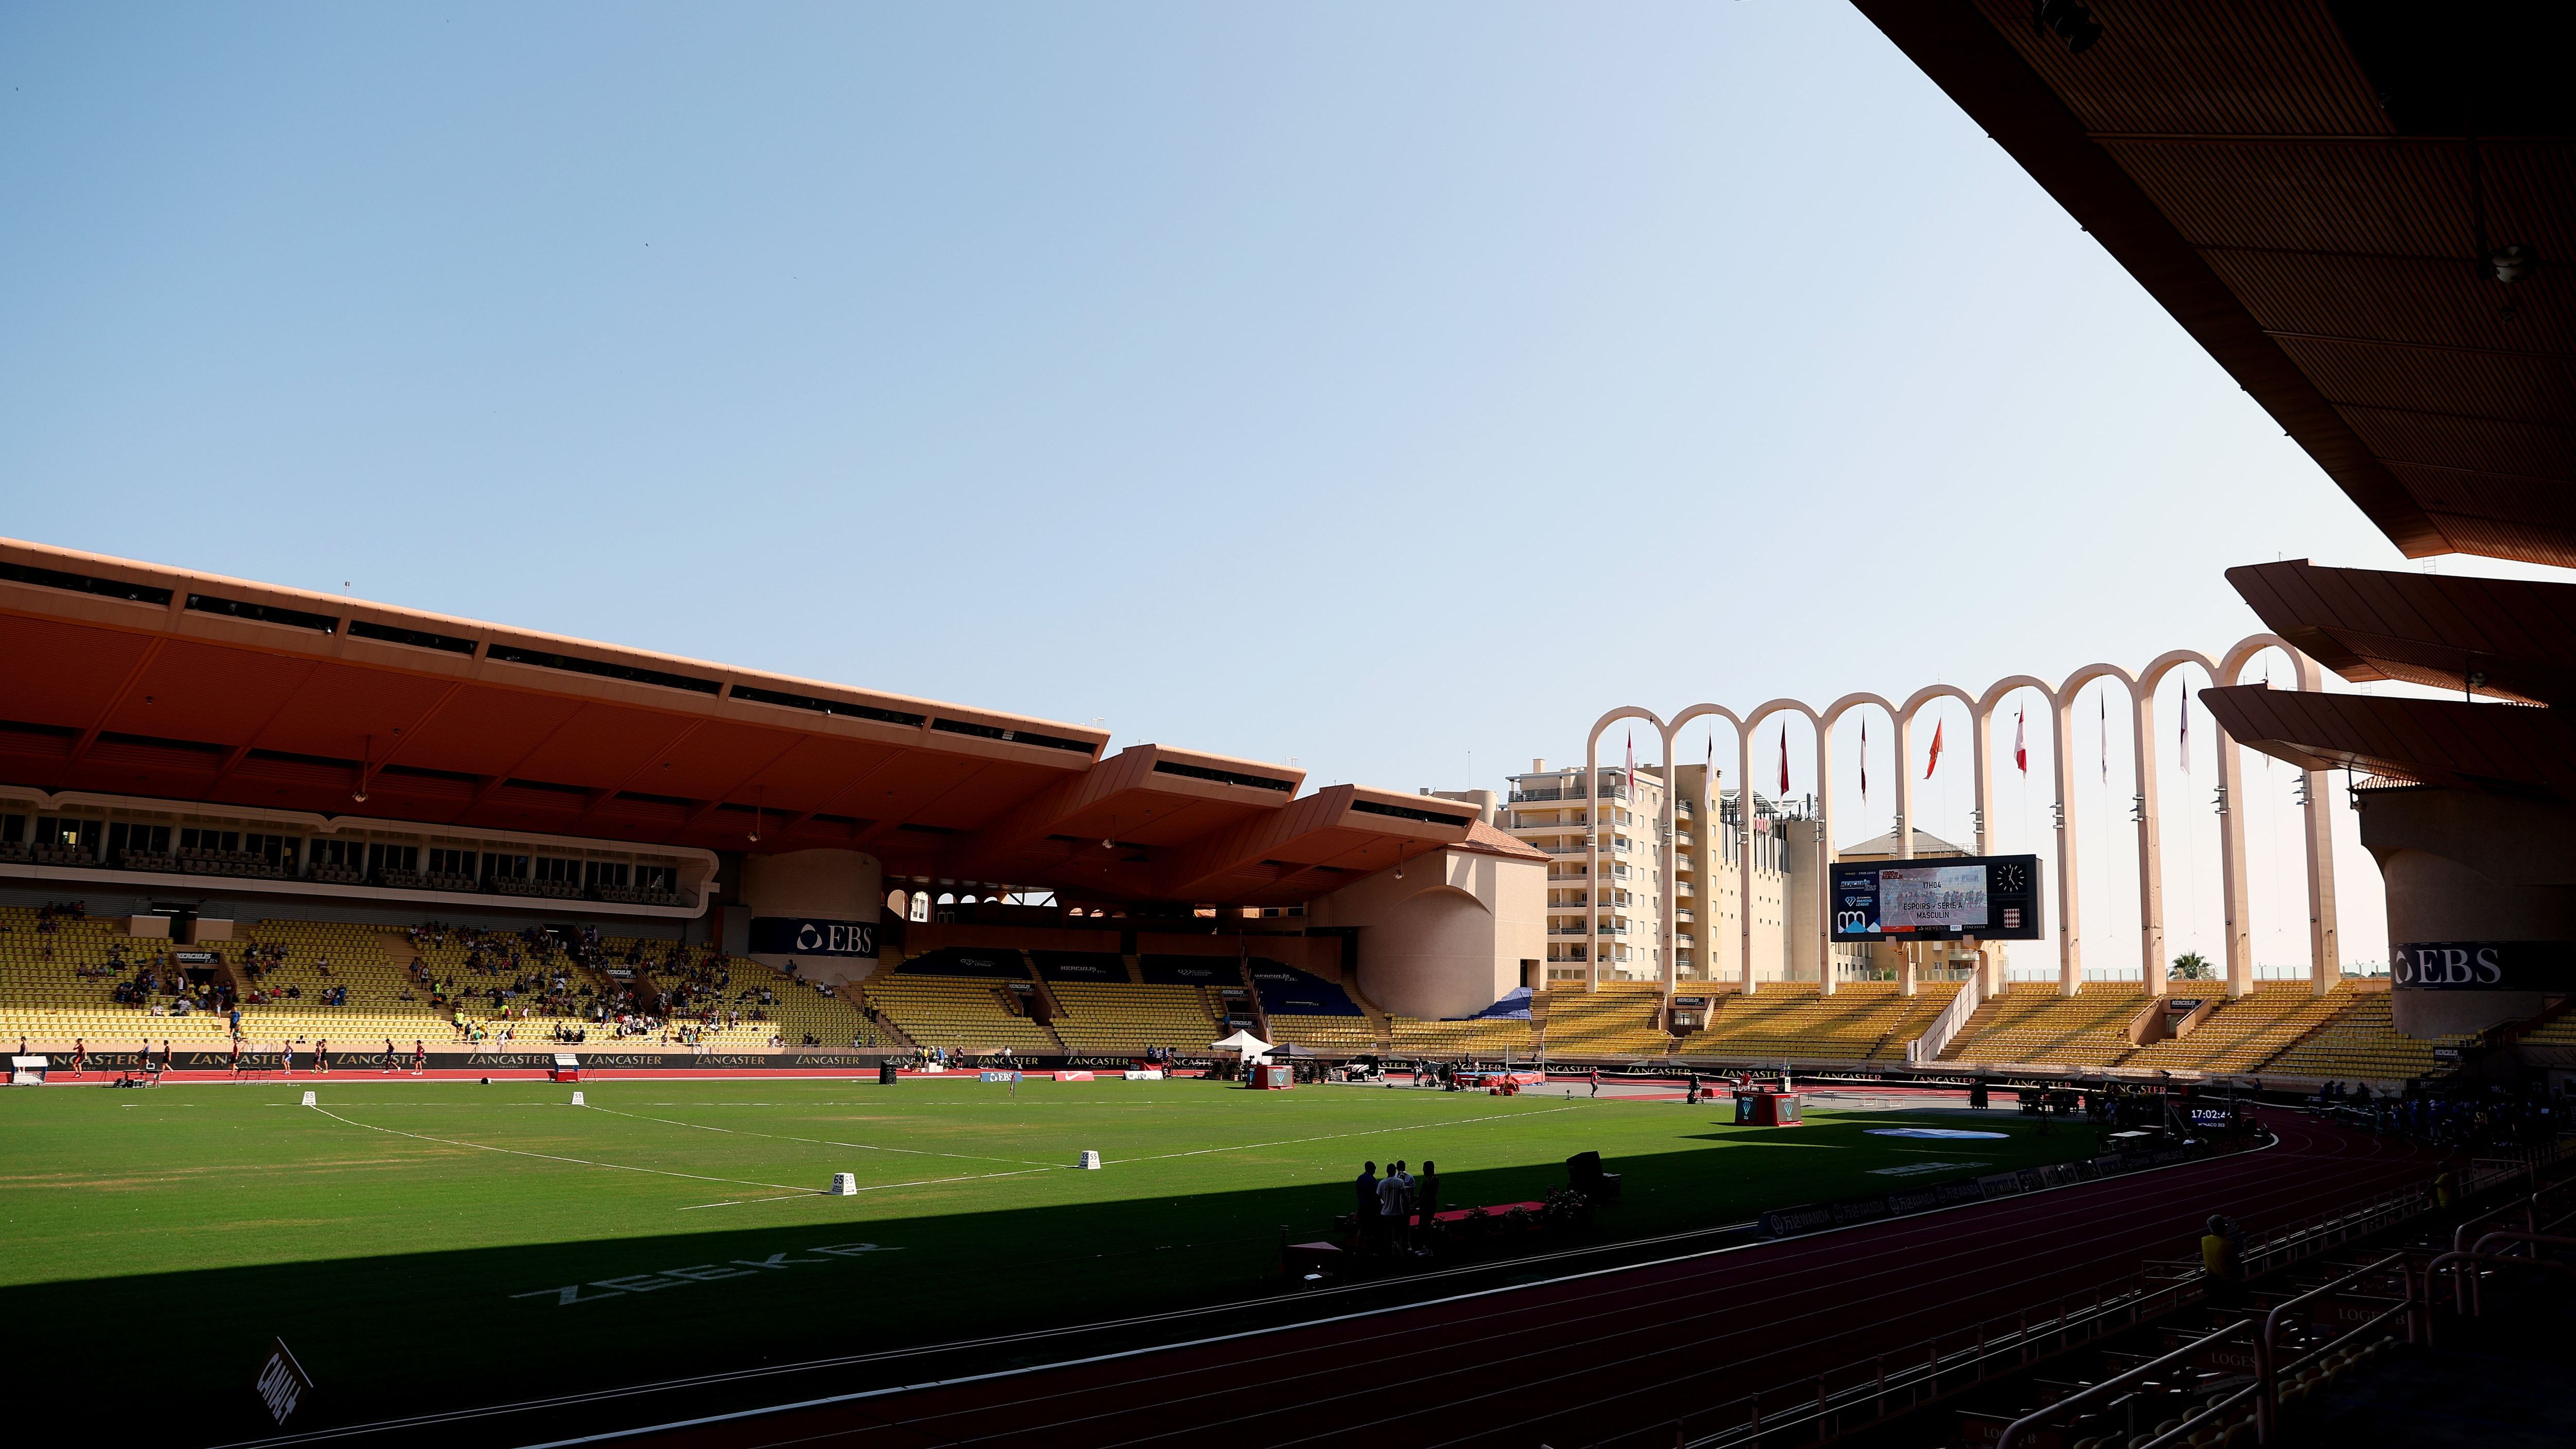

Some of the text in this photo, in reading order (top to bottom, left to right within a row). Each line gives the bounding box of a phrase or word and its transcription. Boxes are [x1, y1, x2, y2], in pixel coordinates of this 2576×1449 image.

[826, 925, 872, 953] EBS
[2415, 948, 2502, 984] EBS
[32, 1054, 138, 1065] NCASTER
[189, 1053, 291, 1064] LANASTE
[467, 1053, 549, 1064] LANCASTER
[586, 1054, 662, 1064] LANCASTER
[695, 1055, 765, 1064] LANCASTER
[795, 1055, 859, 1064] LANCASTER
[1067, 1056, 1129, 1065] LANCASTER
[1626, 1066, 1691, 1076] LANCASTER
[1721, 1069, 1785, 1078] LANASTER
[1818, 1071, 1882, 1081] LANCASTER
[998, 1073, 1013, 1081] EBS
[1912, 1074, 1976, 1085] LANCASTER
[834, 1175, 843, 1184] 65
[845, 1175, 853, 1184] 65
[509, 1243, 907, 1306] ZEEKR
[2211, 1352, 2256, 1368] LOGES
